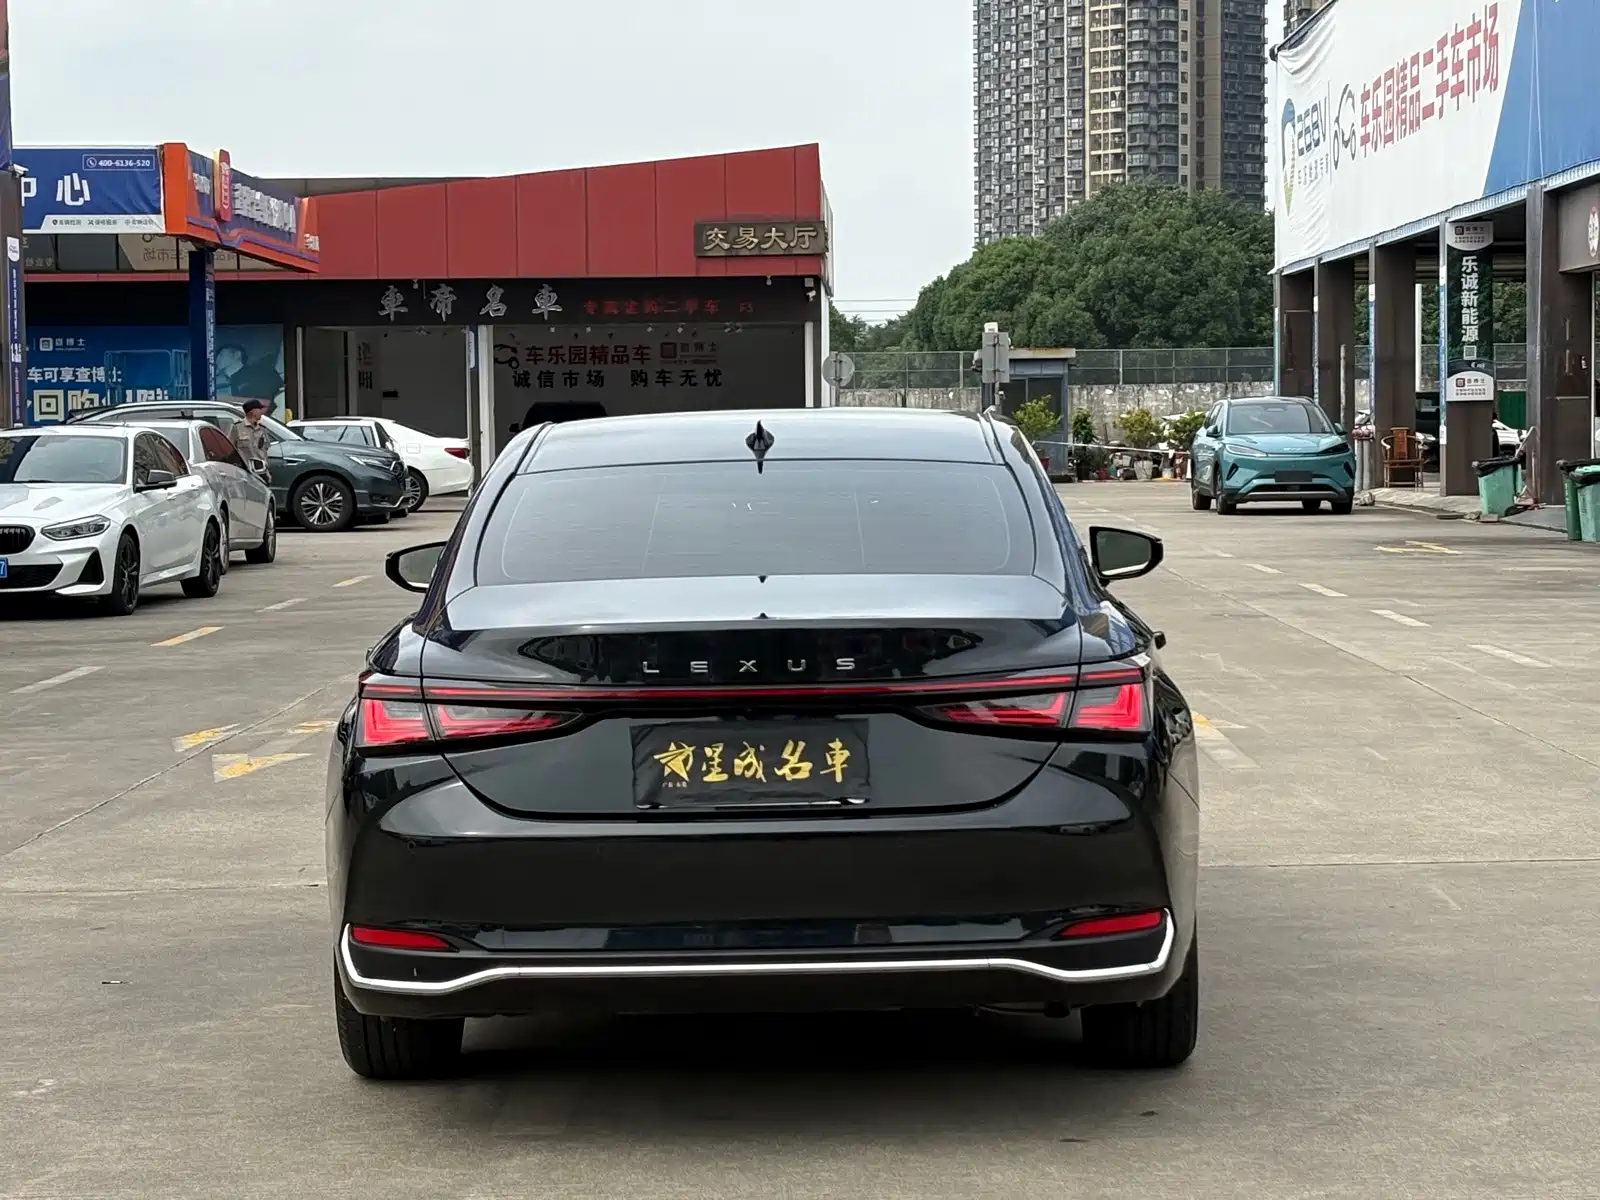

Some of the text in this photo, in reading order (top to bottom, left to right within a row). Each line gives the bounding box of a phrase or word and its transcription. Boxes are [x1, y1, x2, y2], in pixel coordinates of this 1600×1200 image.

[1360, 2, 1499, 158] 车乐园精品二手车市场
[703, 226, 817, 251] 交易大厅
[1460, 255, 1479, 343] 乐诚新能源
[525, 344, 652, 365] 车乐园精品车
[512, 369, 723, 388] 诚信市场 购车无忧
[642, 657, 856, 673] LEXUS
